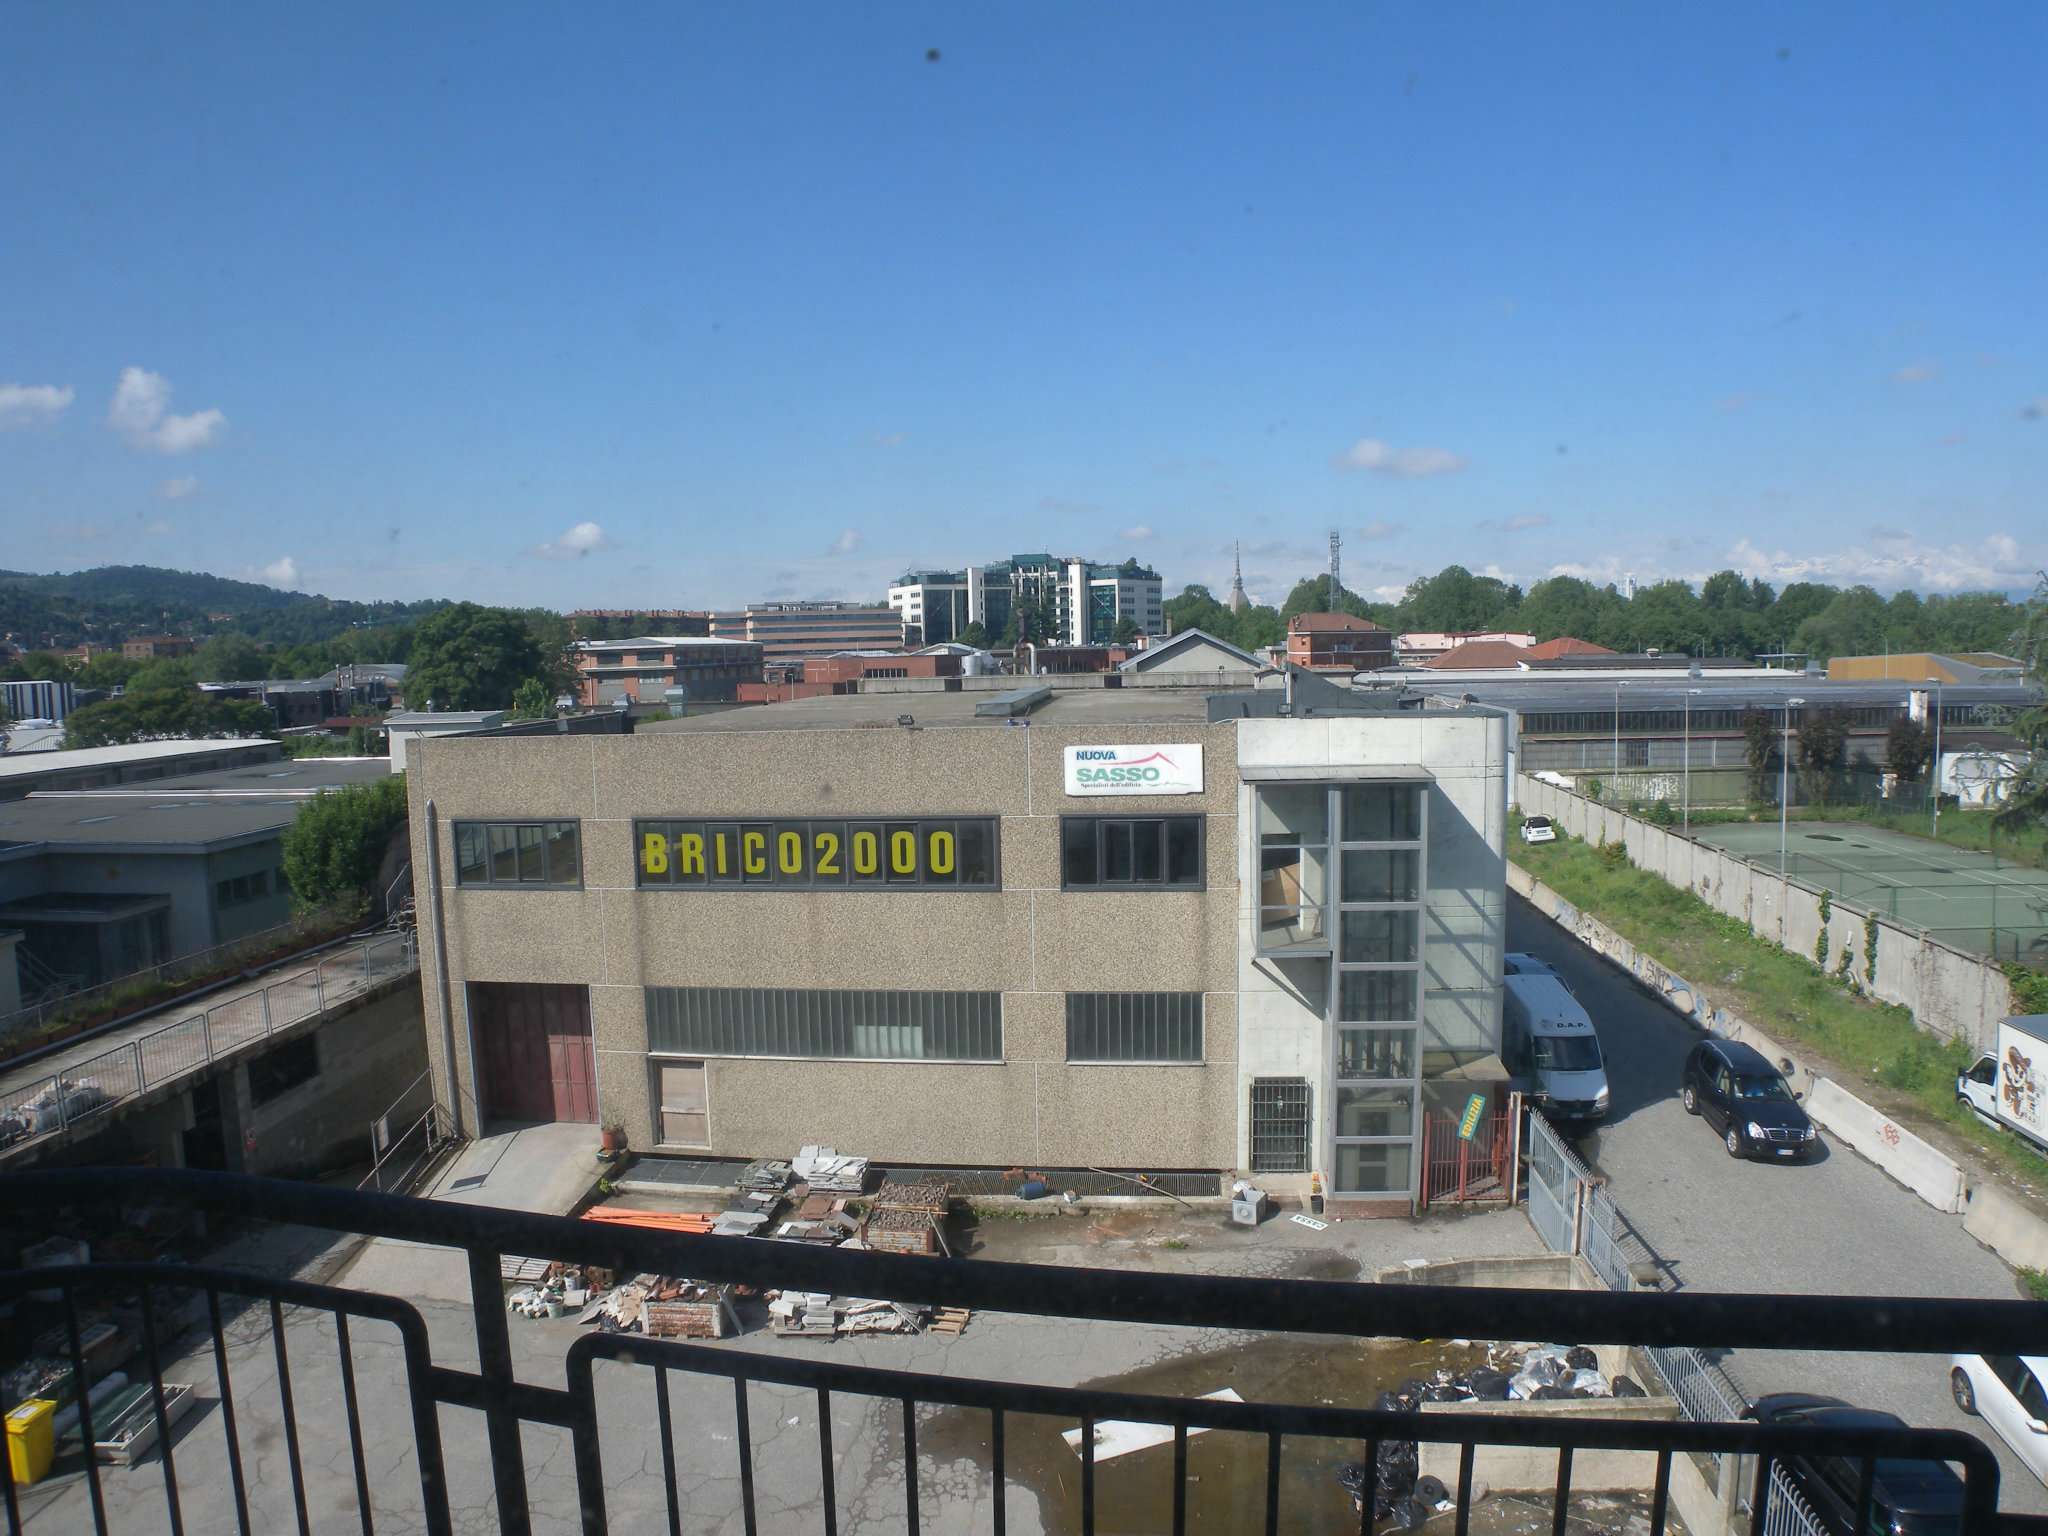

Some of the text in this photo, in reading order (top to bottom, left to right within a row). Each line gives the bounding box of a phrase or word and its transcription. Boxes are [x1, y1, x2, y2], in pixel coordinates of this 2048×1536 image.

[1076, 751, 1117, 761] NUOVA
[1076, 767, 1160, 782] SASSO
[644, 831, 955, 875] BRICO2000
